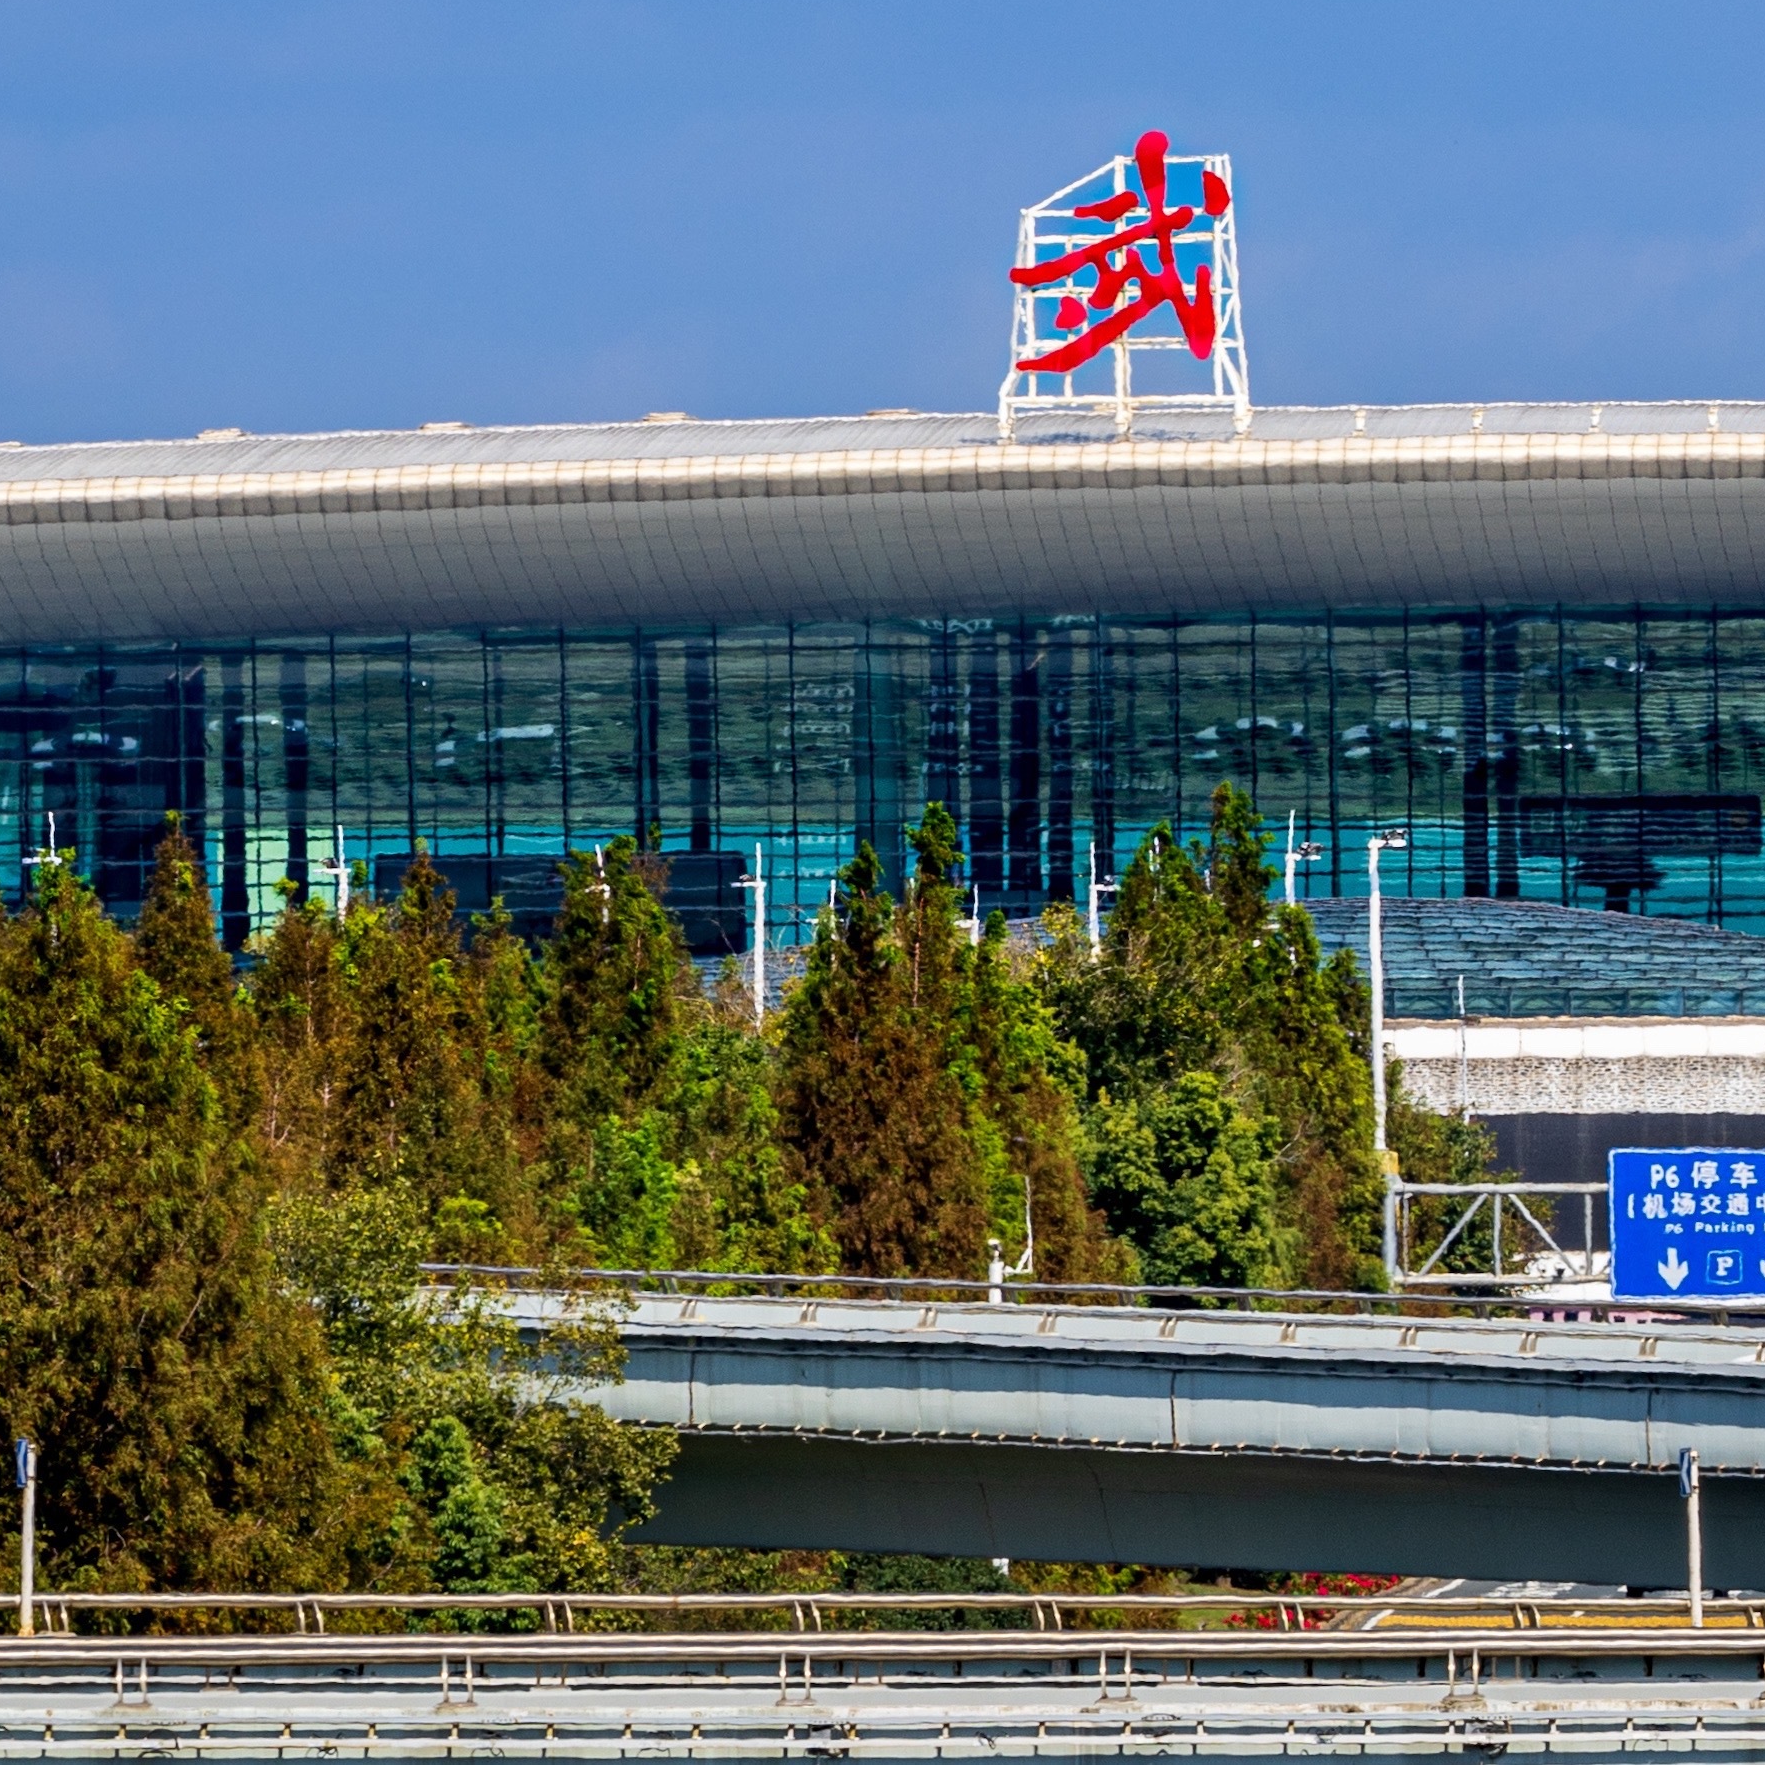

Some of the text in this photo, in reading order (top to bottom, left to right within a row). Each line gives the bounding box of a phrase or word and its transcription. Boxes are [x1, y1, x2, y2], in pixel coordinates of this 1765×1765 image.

[1664, 1222, 1684, 1235] P6
[1694, 1221, 1755, 1235] Parking
[1715, 1256, 1734, 1276] P
